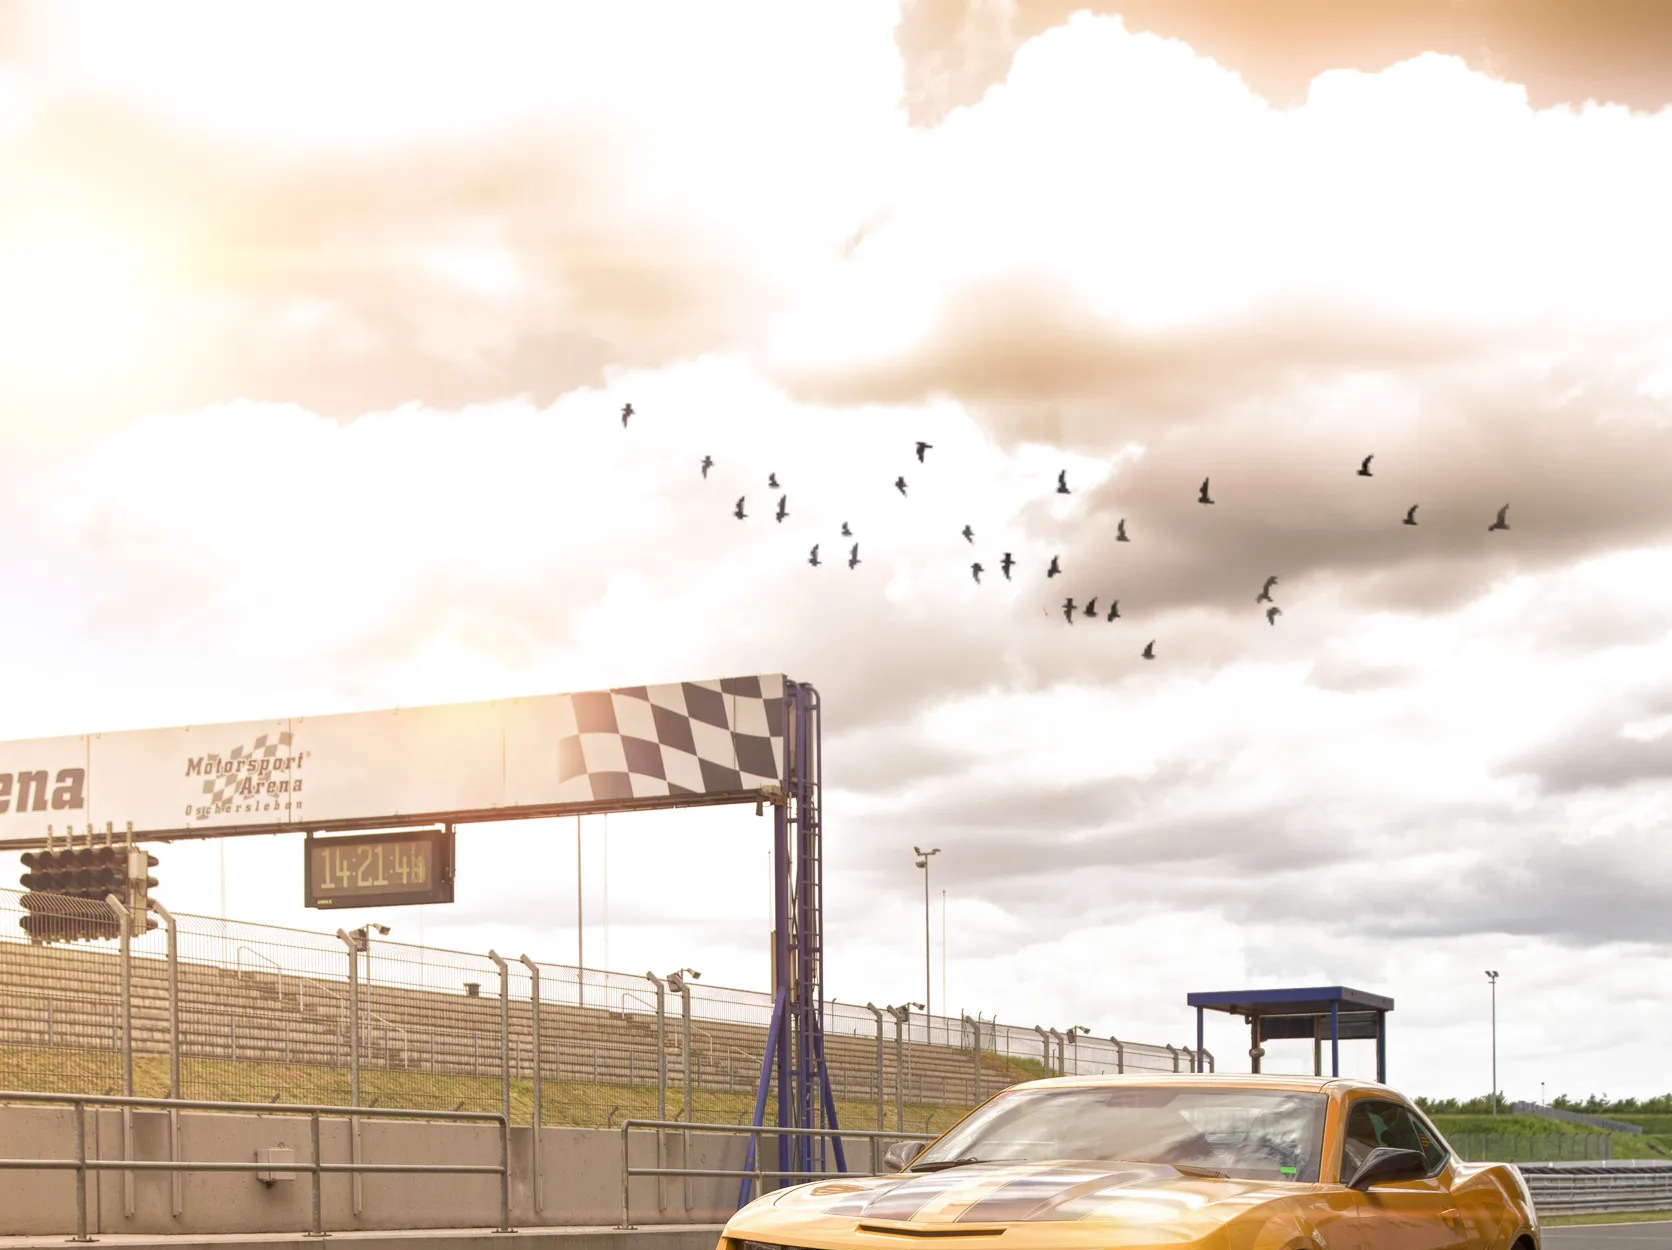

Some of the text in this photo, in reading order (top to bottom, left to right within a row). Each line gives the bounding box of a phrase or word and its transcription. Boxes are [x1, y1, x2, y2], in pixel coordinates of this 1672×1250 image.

[185, 752, 303, 777] Motorsport
[239, 776, 303, 795] Arena
[185, 800, 303, 816] Oschersleben
